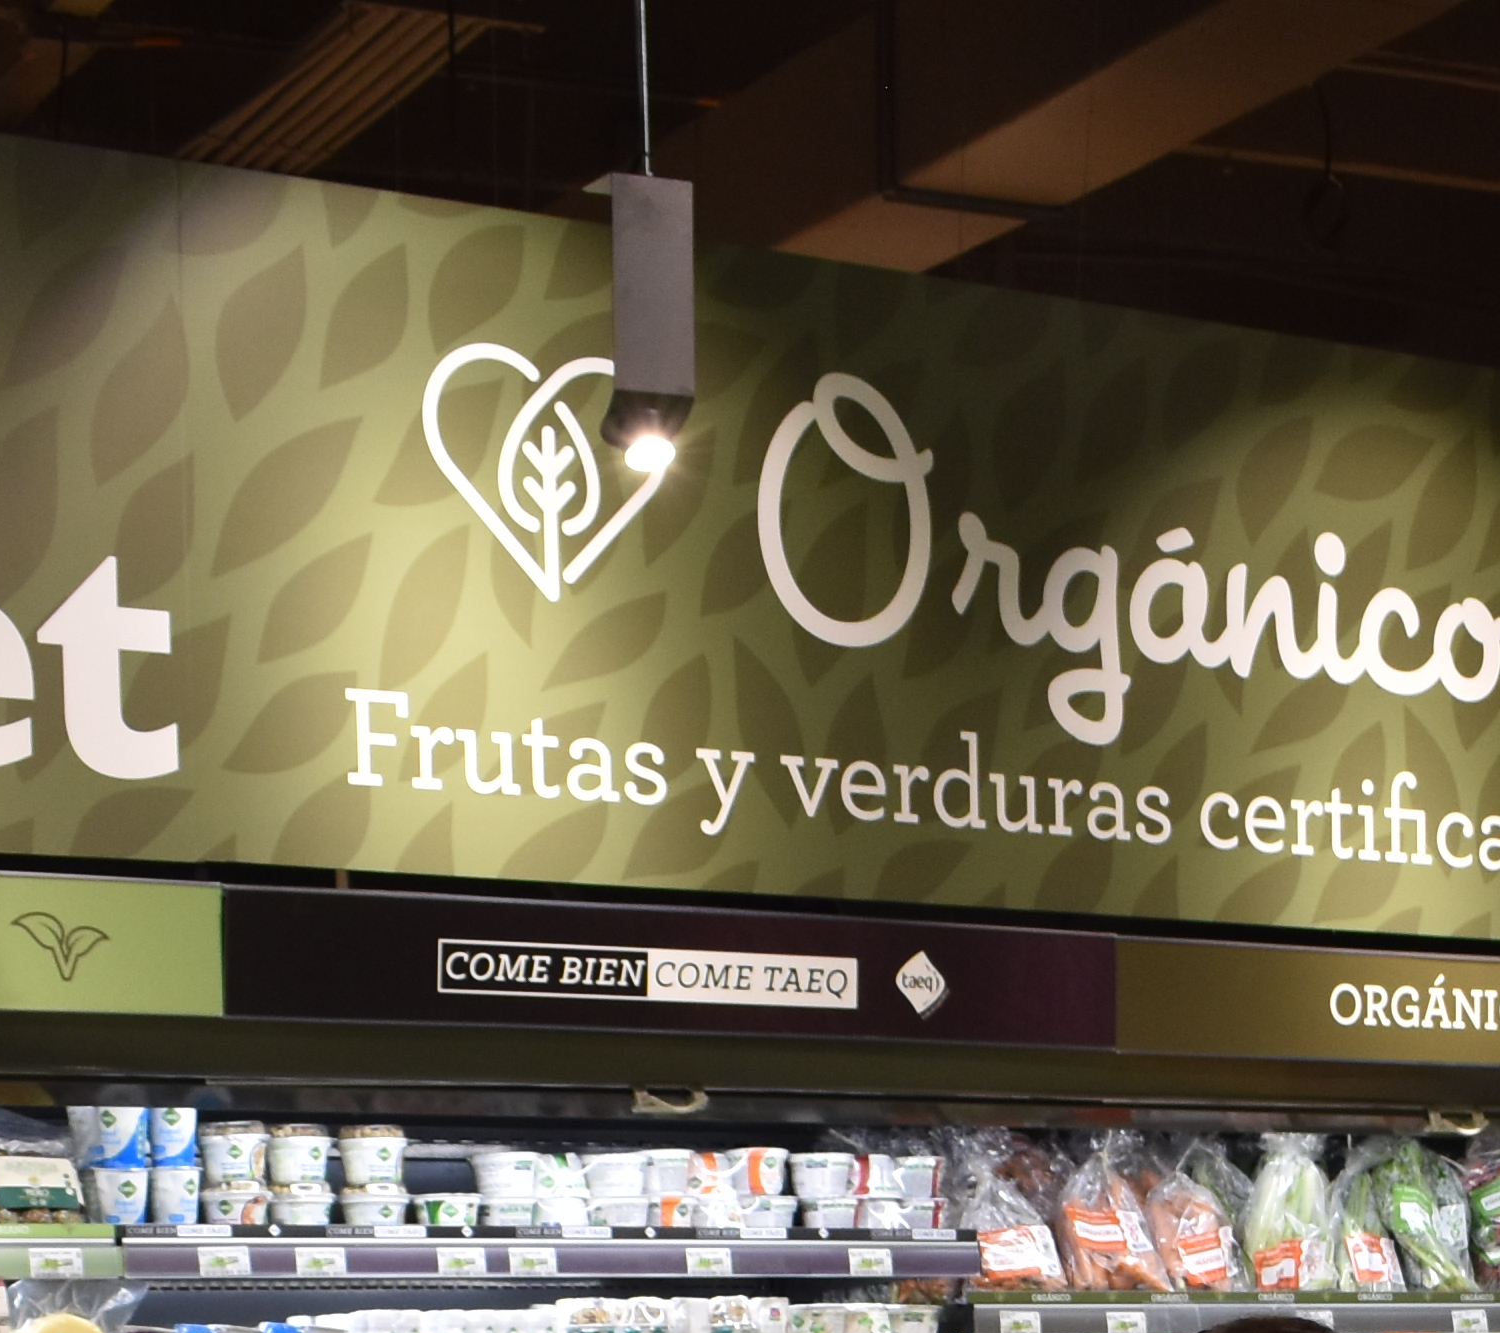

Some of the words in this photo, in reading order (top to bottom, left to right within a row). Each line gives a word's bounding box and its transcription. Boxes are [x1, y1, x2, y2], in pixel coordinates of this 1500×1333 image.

[344, 687, 668, 807] Frutas
[695, 748, 756, 838] y
[780, 732, 1173, 846] verduras
[444, 951, 551, 987] COME
[558, 955, 648, 991] BIEN
[654, 959, 751, 995] COME
[758, 963, 849, 999] TAEQ
